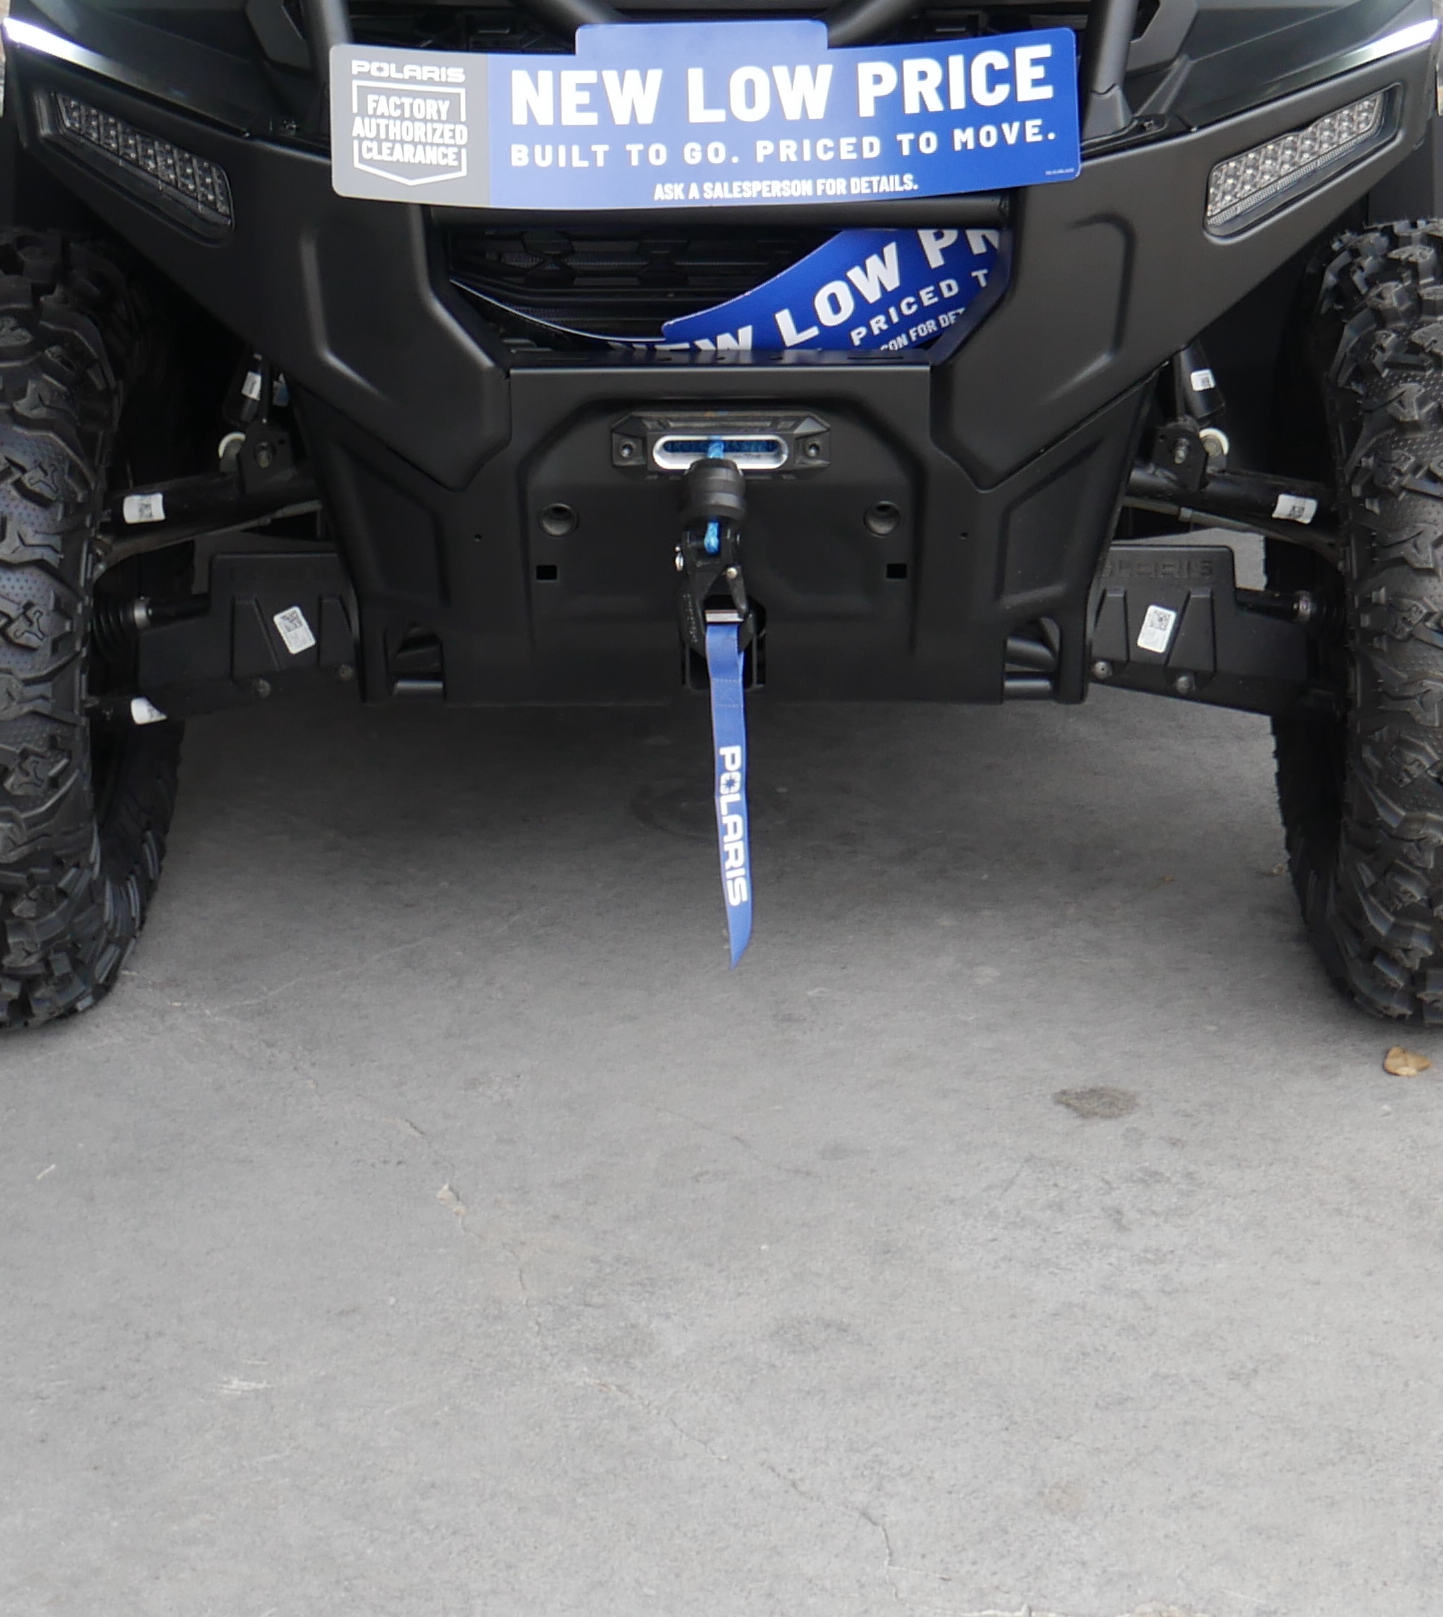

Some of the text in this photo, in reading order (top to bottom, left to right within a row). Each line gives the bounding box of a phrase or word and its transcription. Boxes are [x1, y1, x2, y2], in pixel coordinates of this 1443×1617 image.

[351, 59, 466, 83] POLARIS
[511, 43, 1054, 125] NEW LOW PRICE
[367, 94, 450, 120] FACTORY
[352, 116, 468, 145] AUTHORIZED
[511, 119, 1056, 167] BUILT TO GO. PRICED TO MOVE.
[361, 140, 458, 166] CLEARANCE
[653, 173, 919, 201] ASK A SALESPERSON FOR DETAILS.
[774, 241, 901, 347] LOW
[850, 278, 959, 347] PRICED
[909, 319, 938, 342] FOR
[719, 745, 748, 907] POLARIS
